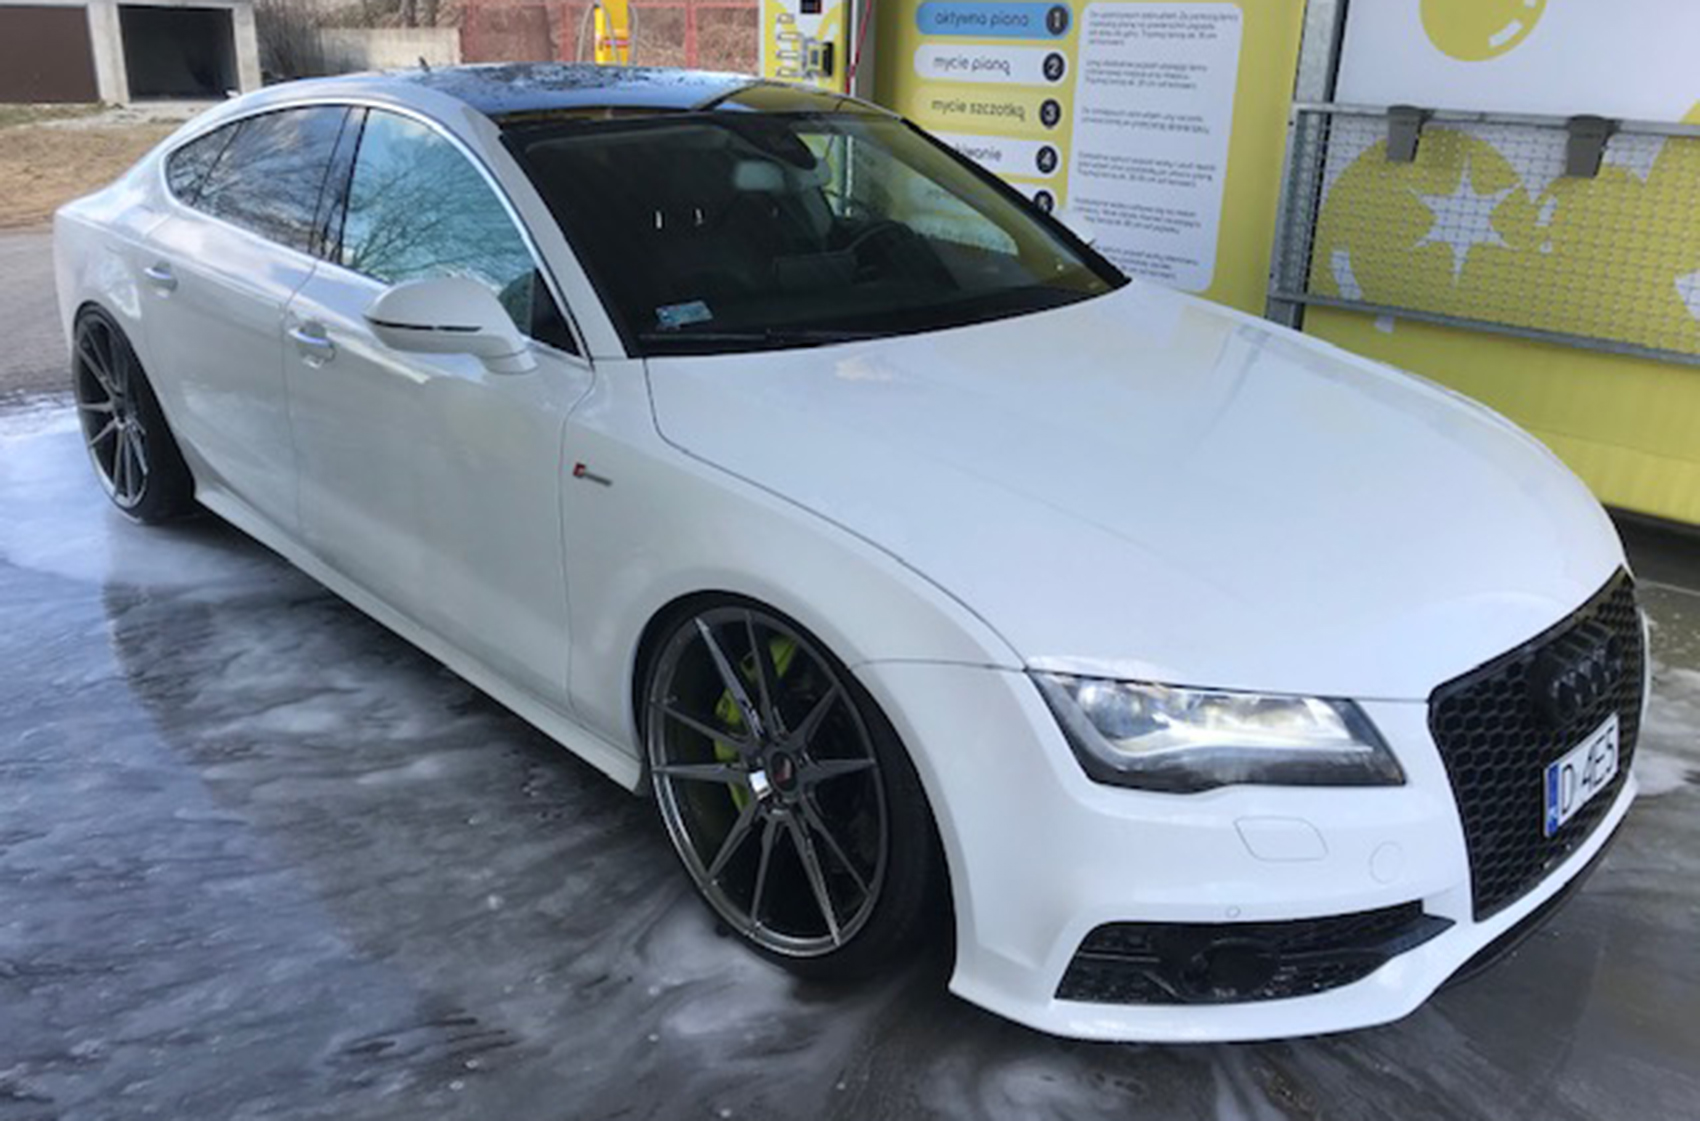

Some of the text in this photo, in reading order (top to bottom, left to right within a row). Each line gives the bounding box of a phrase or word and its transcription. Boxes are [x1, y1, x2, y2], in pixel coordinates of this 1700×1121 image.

[934, 11, 986, 28] aktywna
[990, 12, 1029, 28] piana
[933, 55, 969, 71] mycie
[1048, 56, 1060, 76] 2
[931, 98, 966, 114] mycie
[1043, 103, 1056, 122] 3
[1041, 149, 1053, 169] 4
[1561, 763, 1576, 815] D
